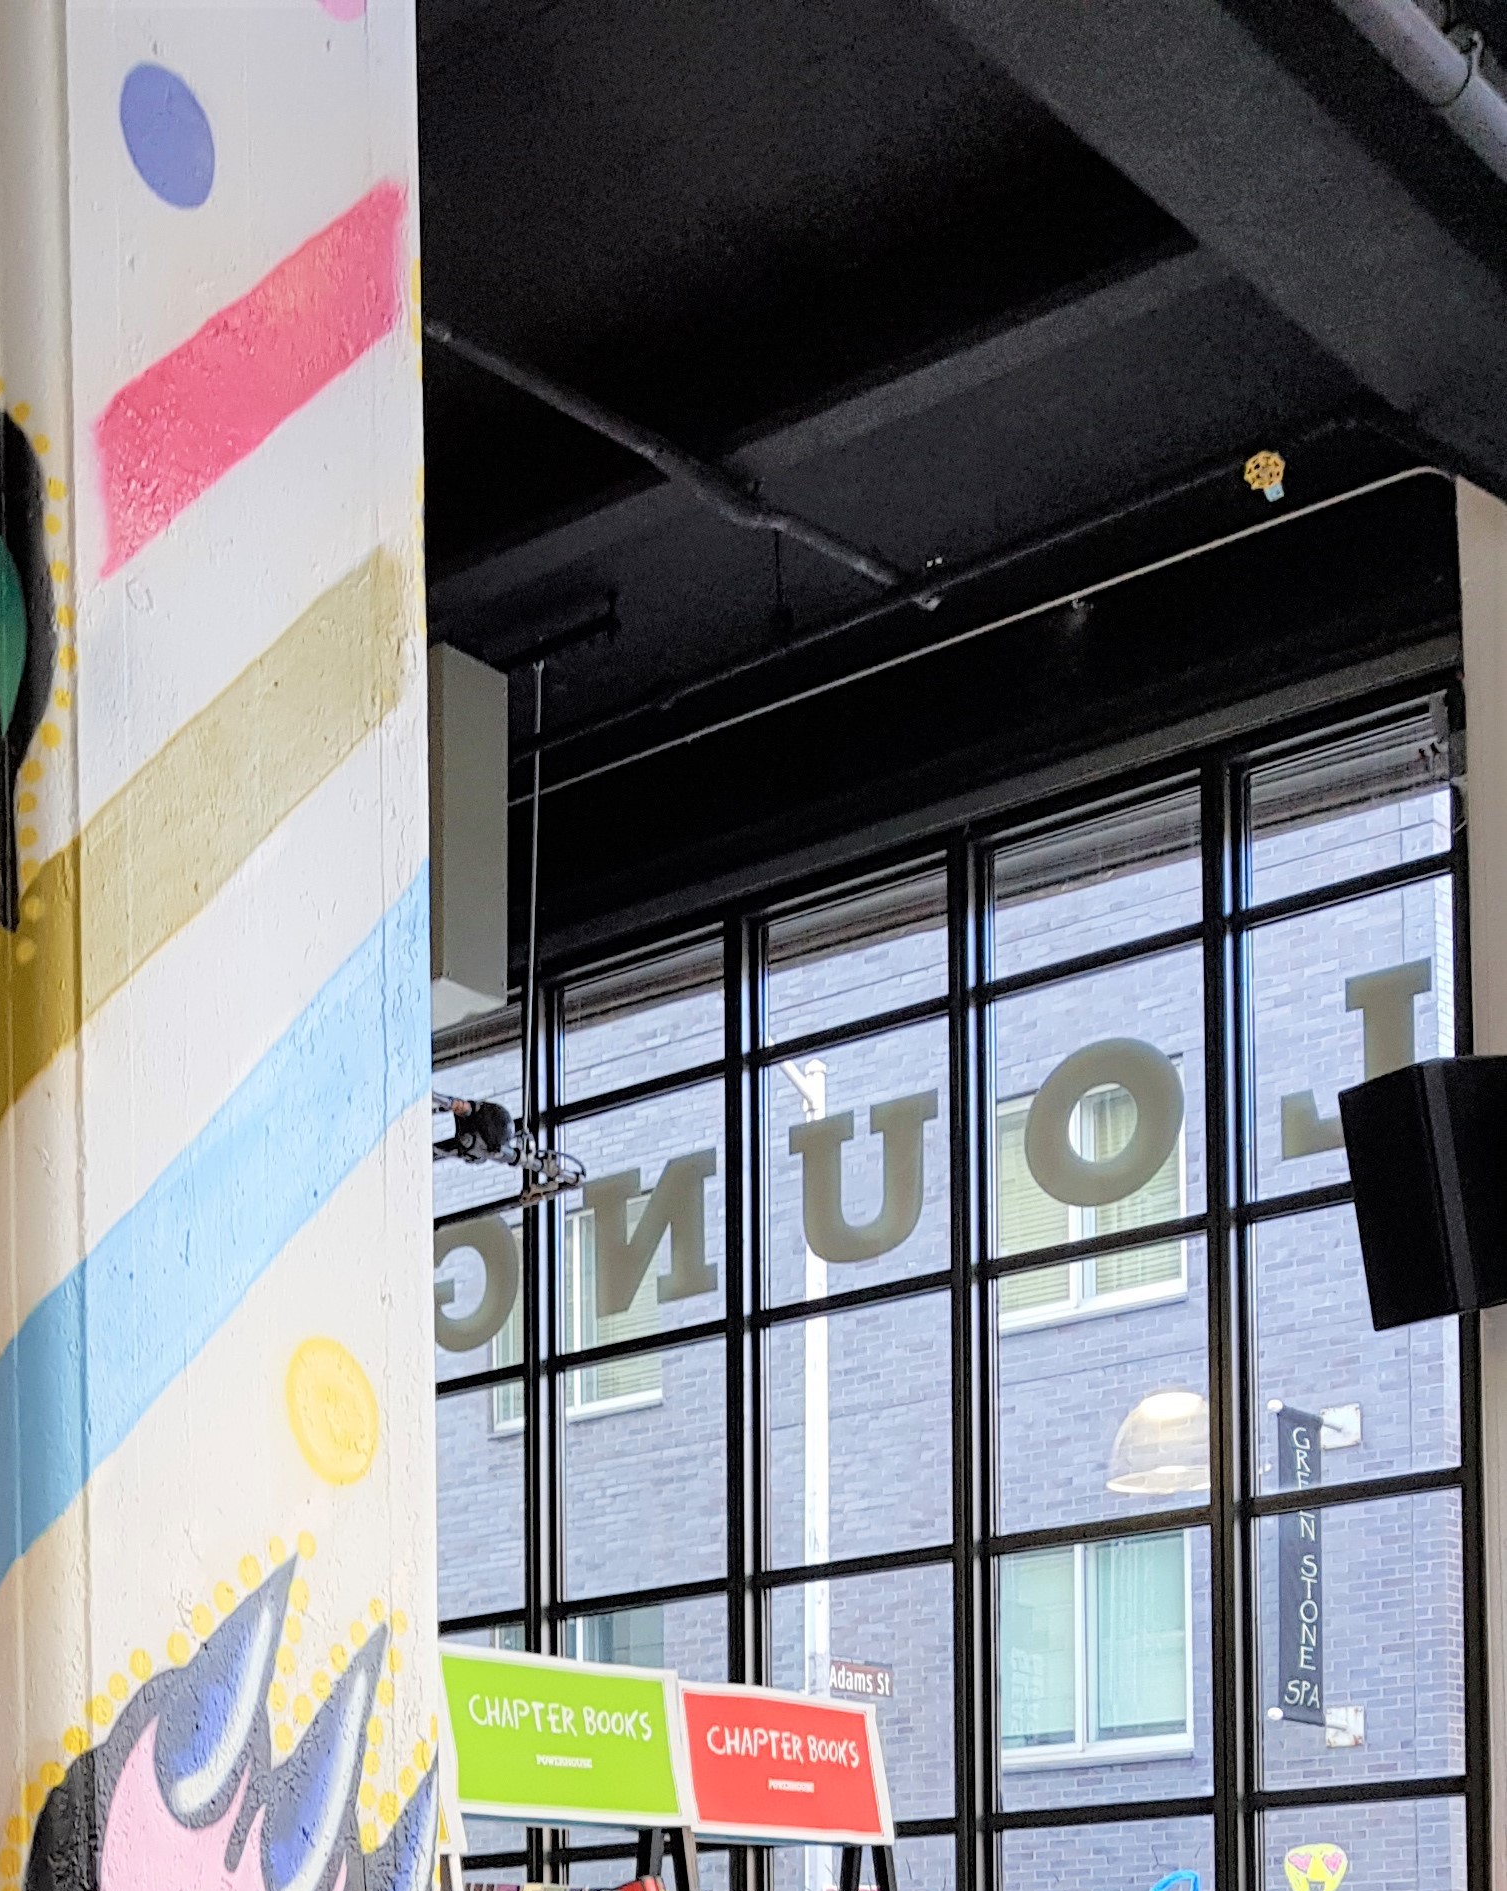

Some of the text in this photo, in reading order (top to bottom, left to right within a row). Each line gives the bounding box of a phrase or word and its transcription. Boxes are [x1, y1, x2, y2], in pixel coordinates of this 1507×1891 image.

[1284, 1427, 1320, 1709] GREN STONE SPA
[829, 1664, 890, 1696] Adams St
[468, 1694, 652, 1742] CHAPTER BOOKS
[536, 1755, 592, 1769] POWERHOUSE
[707, 1726, 860, 1768] CHAPTER BOOKS
